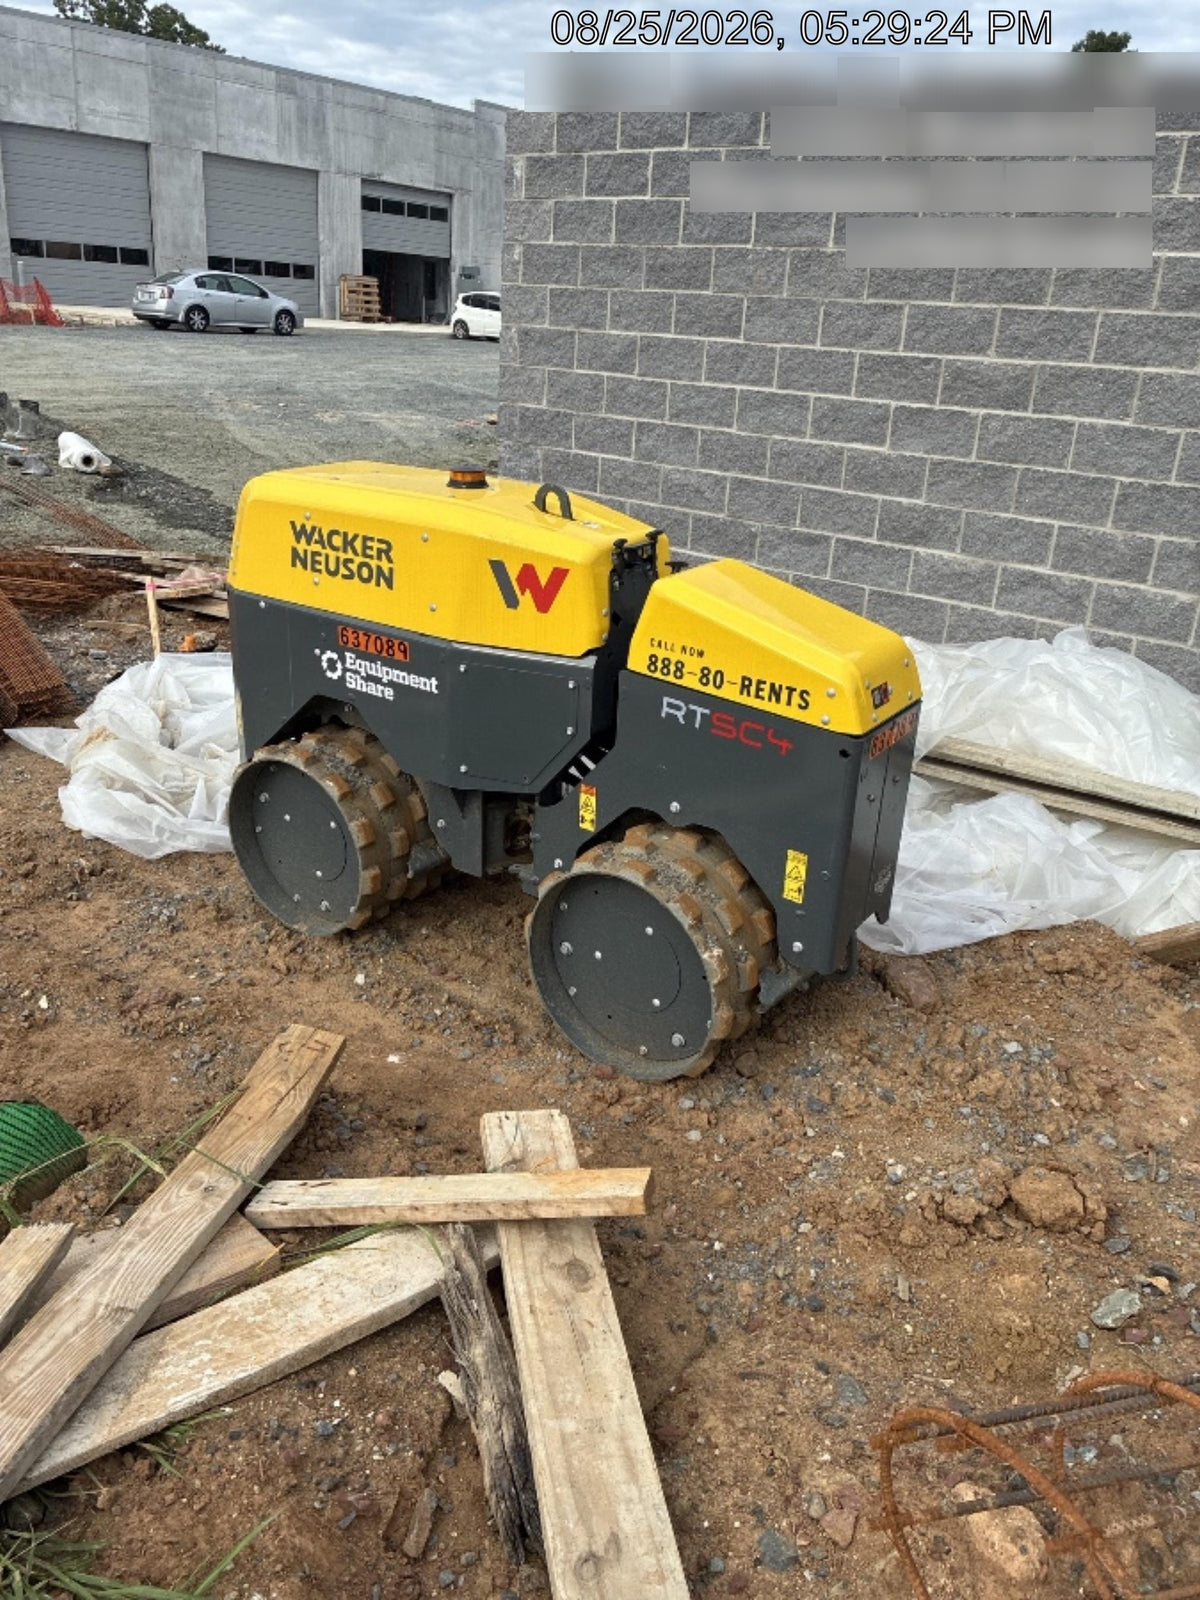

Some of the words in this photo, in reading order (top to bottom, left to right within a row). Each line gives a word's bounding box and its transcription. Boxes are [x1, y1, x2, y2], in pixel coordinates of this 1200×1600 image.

[290, 520, 394, 564] WACKER
[290, 546, 394, 591] NEUSON
[340, 626, 408, 660] 637089
[650, 637, 675, 653] CALL
[680, 644, 705, 659] NOW
[344, 651, 439, 694] Equipment
[345, 672, 394, 701] Share
[647, 653, 811, 711] 888-80-RENTS
